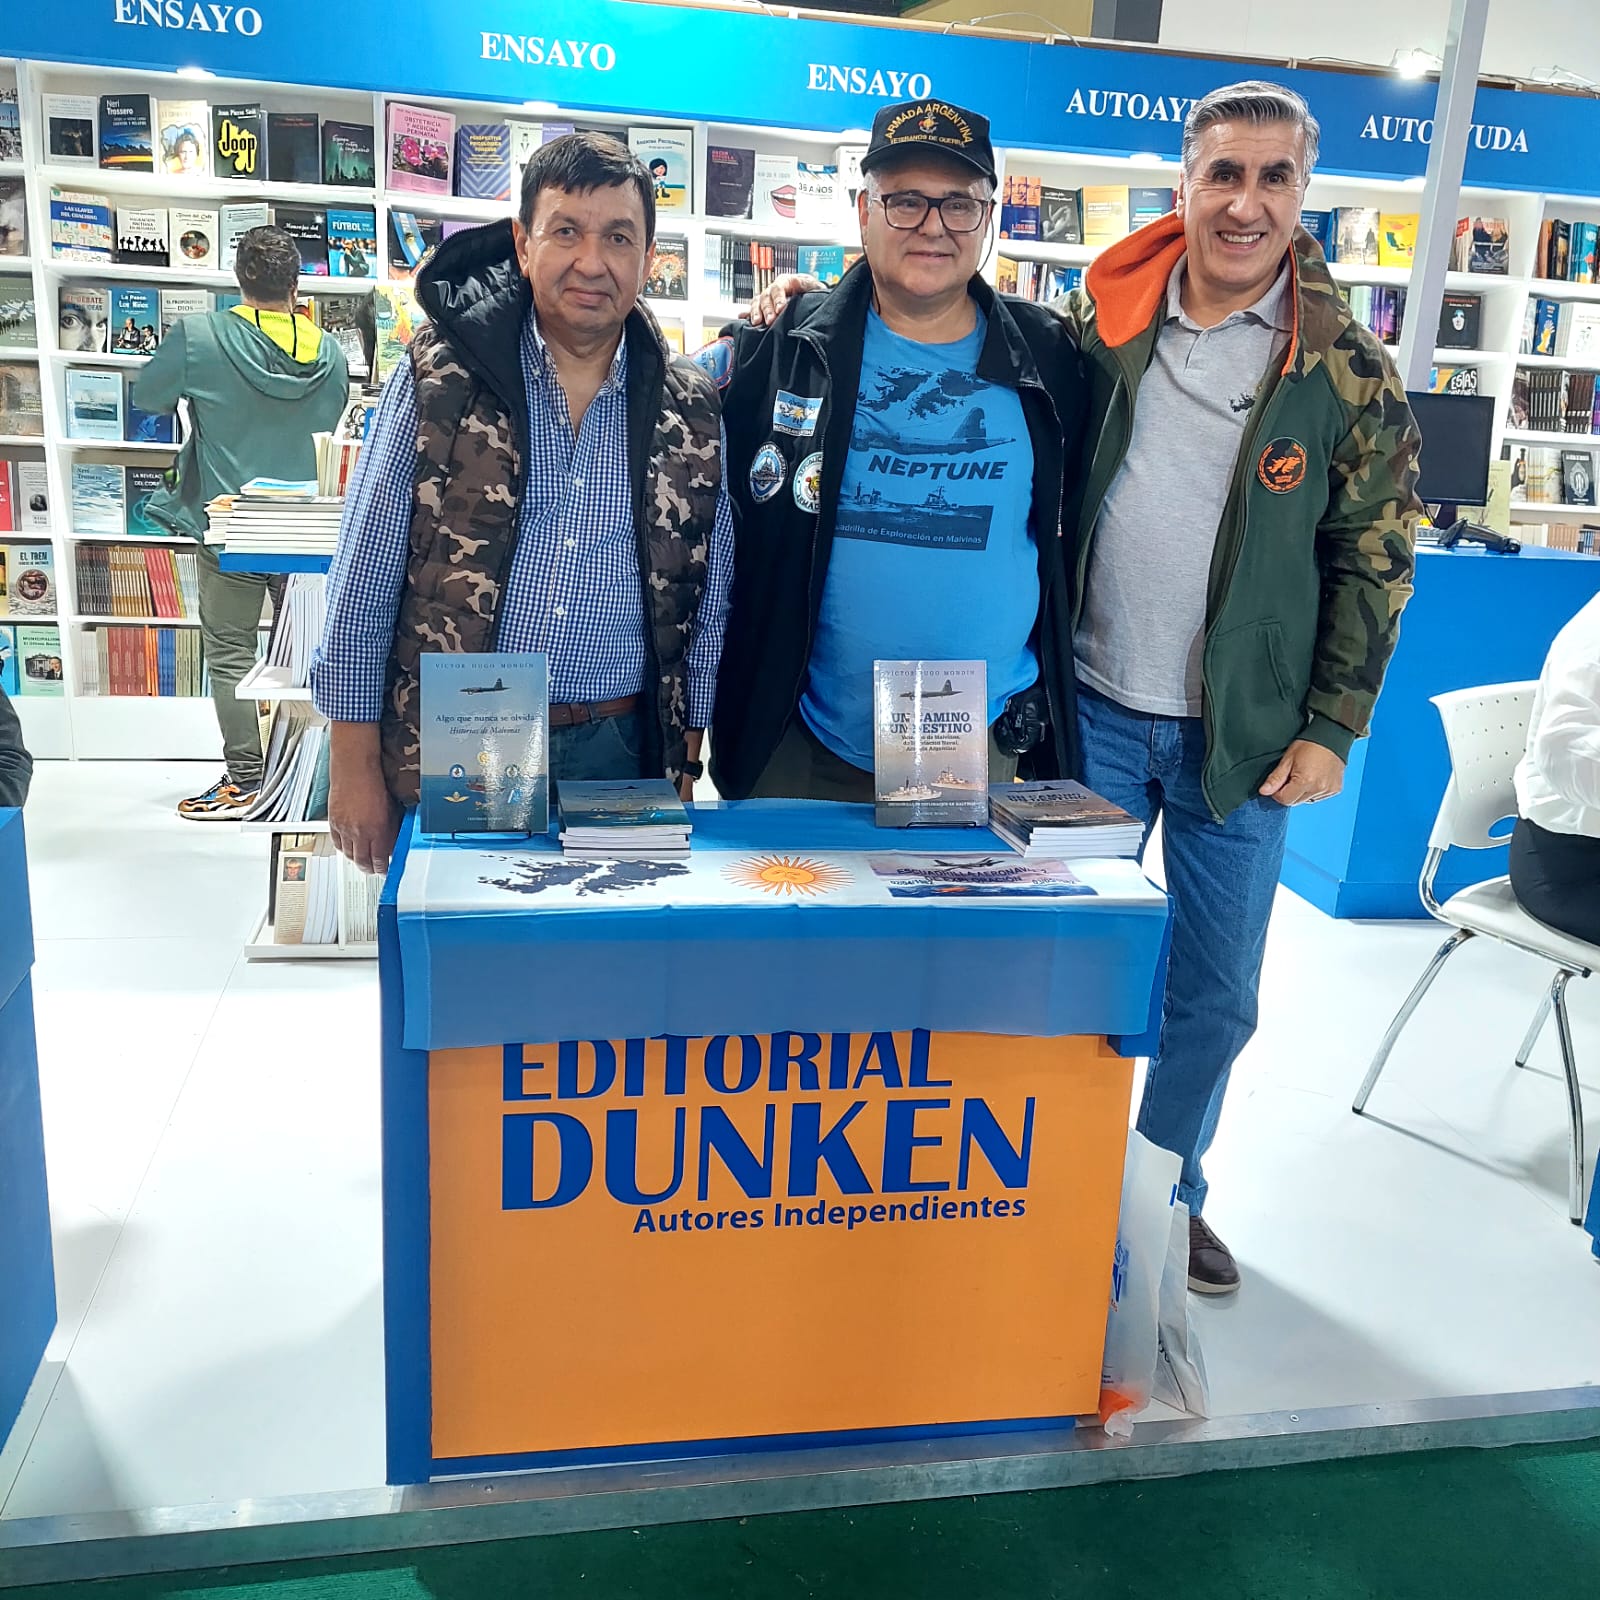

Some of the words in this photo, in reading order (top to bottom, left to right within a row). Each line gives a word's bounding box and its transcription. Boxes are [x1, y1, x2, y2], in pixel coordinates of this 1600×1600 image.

[114, 0, 262, 36] ENSAYO
[480, 31, 616, 72] ENSAYO
[807, 63, 932, 100] ENSAYO
[1066, 88, 1199, 122] AUTOAY
[884, 105, 924, 139] ARMADA
[925, 103, 974, 143] ARGENTINA
[1361, 115, 1529, 152] AUTOUDA
[809, 183, 833, 193] AÑOS
[332, 220, 361, 231] FÚTBOL
[1451, 370, 1477, 390] ESTAS
[868, 454, 1008, 480] NEPTUNE
[867, 525, 878, 535] de
[880, 528, 931, 541] Exploración
[946, 535, 983, 544] Malvinas
[20, 552, 28, 560] EL
[435, 714, 454, 723] Algo
[449, 727, 479, 735] Historias
[490, 726, 521, 734] Malvinas
[912, 723, 972, 733] ESTINO
[897, 868, 973, 877] ESCUADRILLA
[503, 1029, 952, 1102] EDITORIAL
[502, 1097, 1035, 1210] DUNKEN
[633, 1206, 764, 1233] Autores
[774, 1195, 1027, 1230] Independientes
